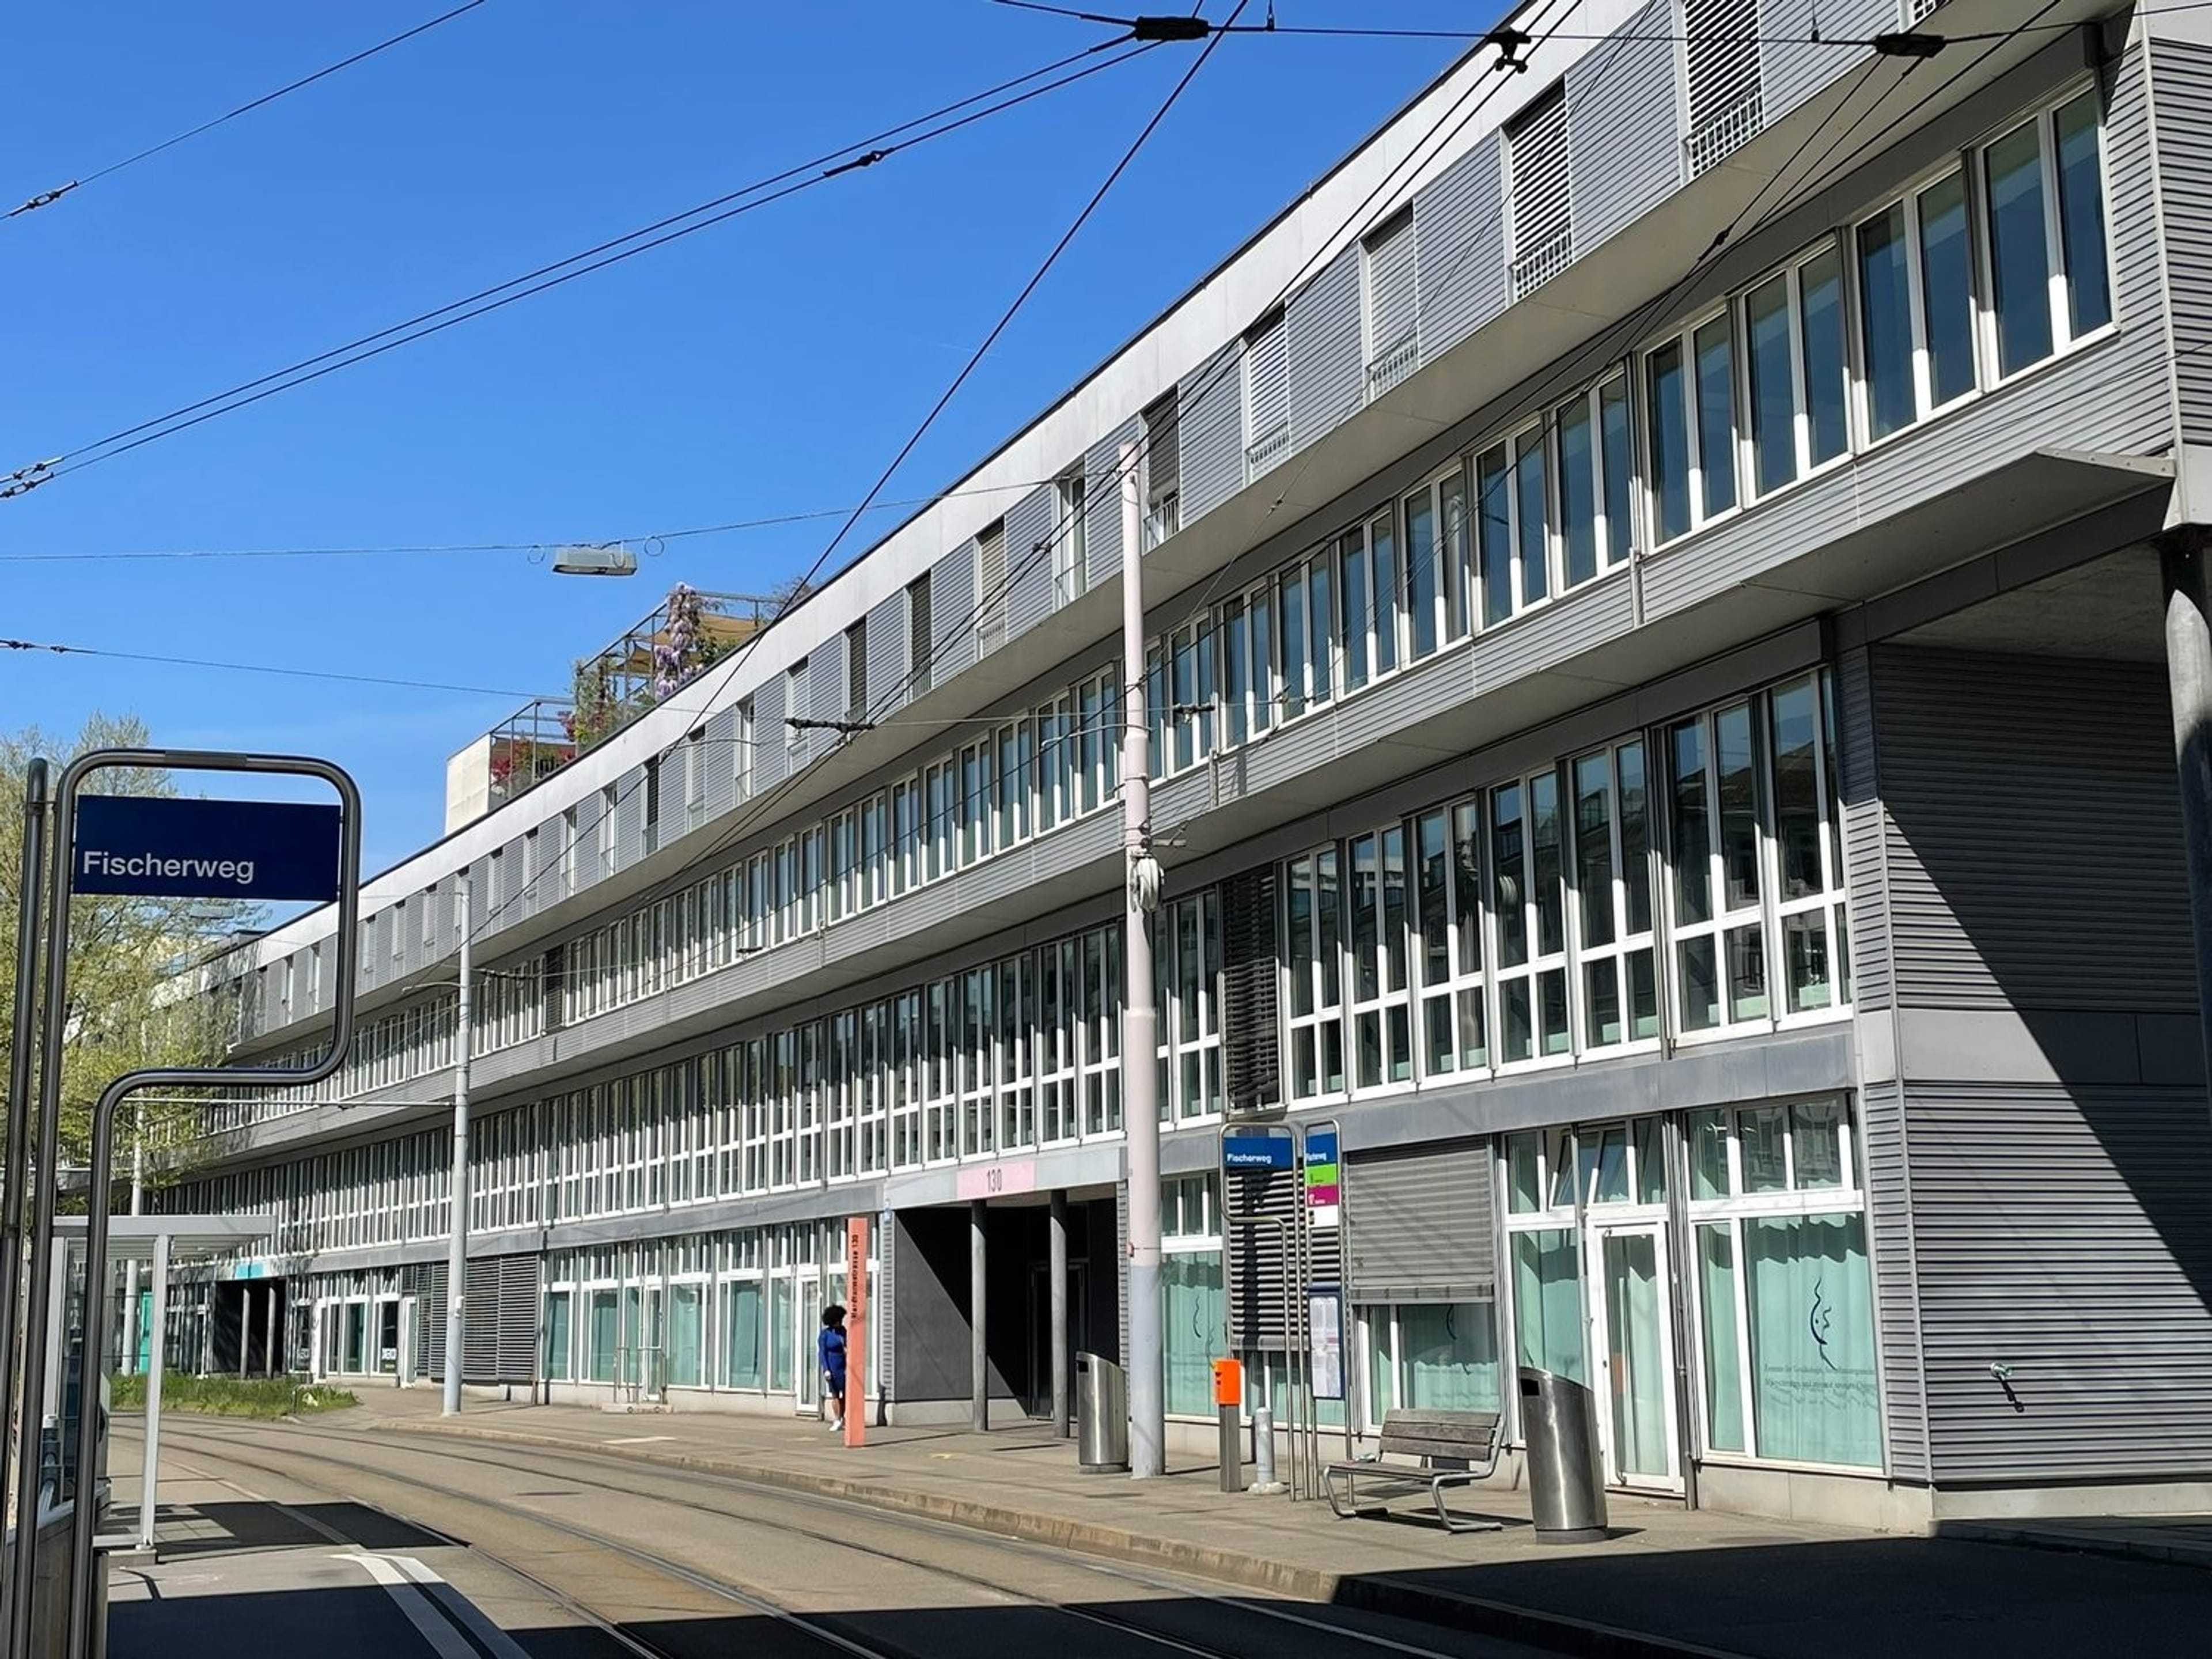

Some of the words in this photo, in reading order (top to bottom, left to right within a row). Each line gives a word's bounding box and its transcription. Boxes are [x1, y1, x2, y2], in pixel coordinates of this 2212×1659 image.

[83, 851, 255, 885] Fischerweg
[1226, 1153, 1272, 1165] Fischerweg
[987, 1168, 1002, 1192] 130
